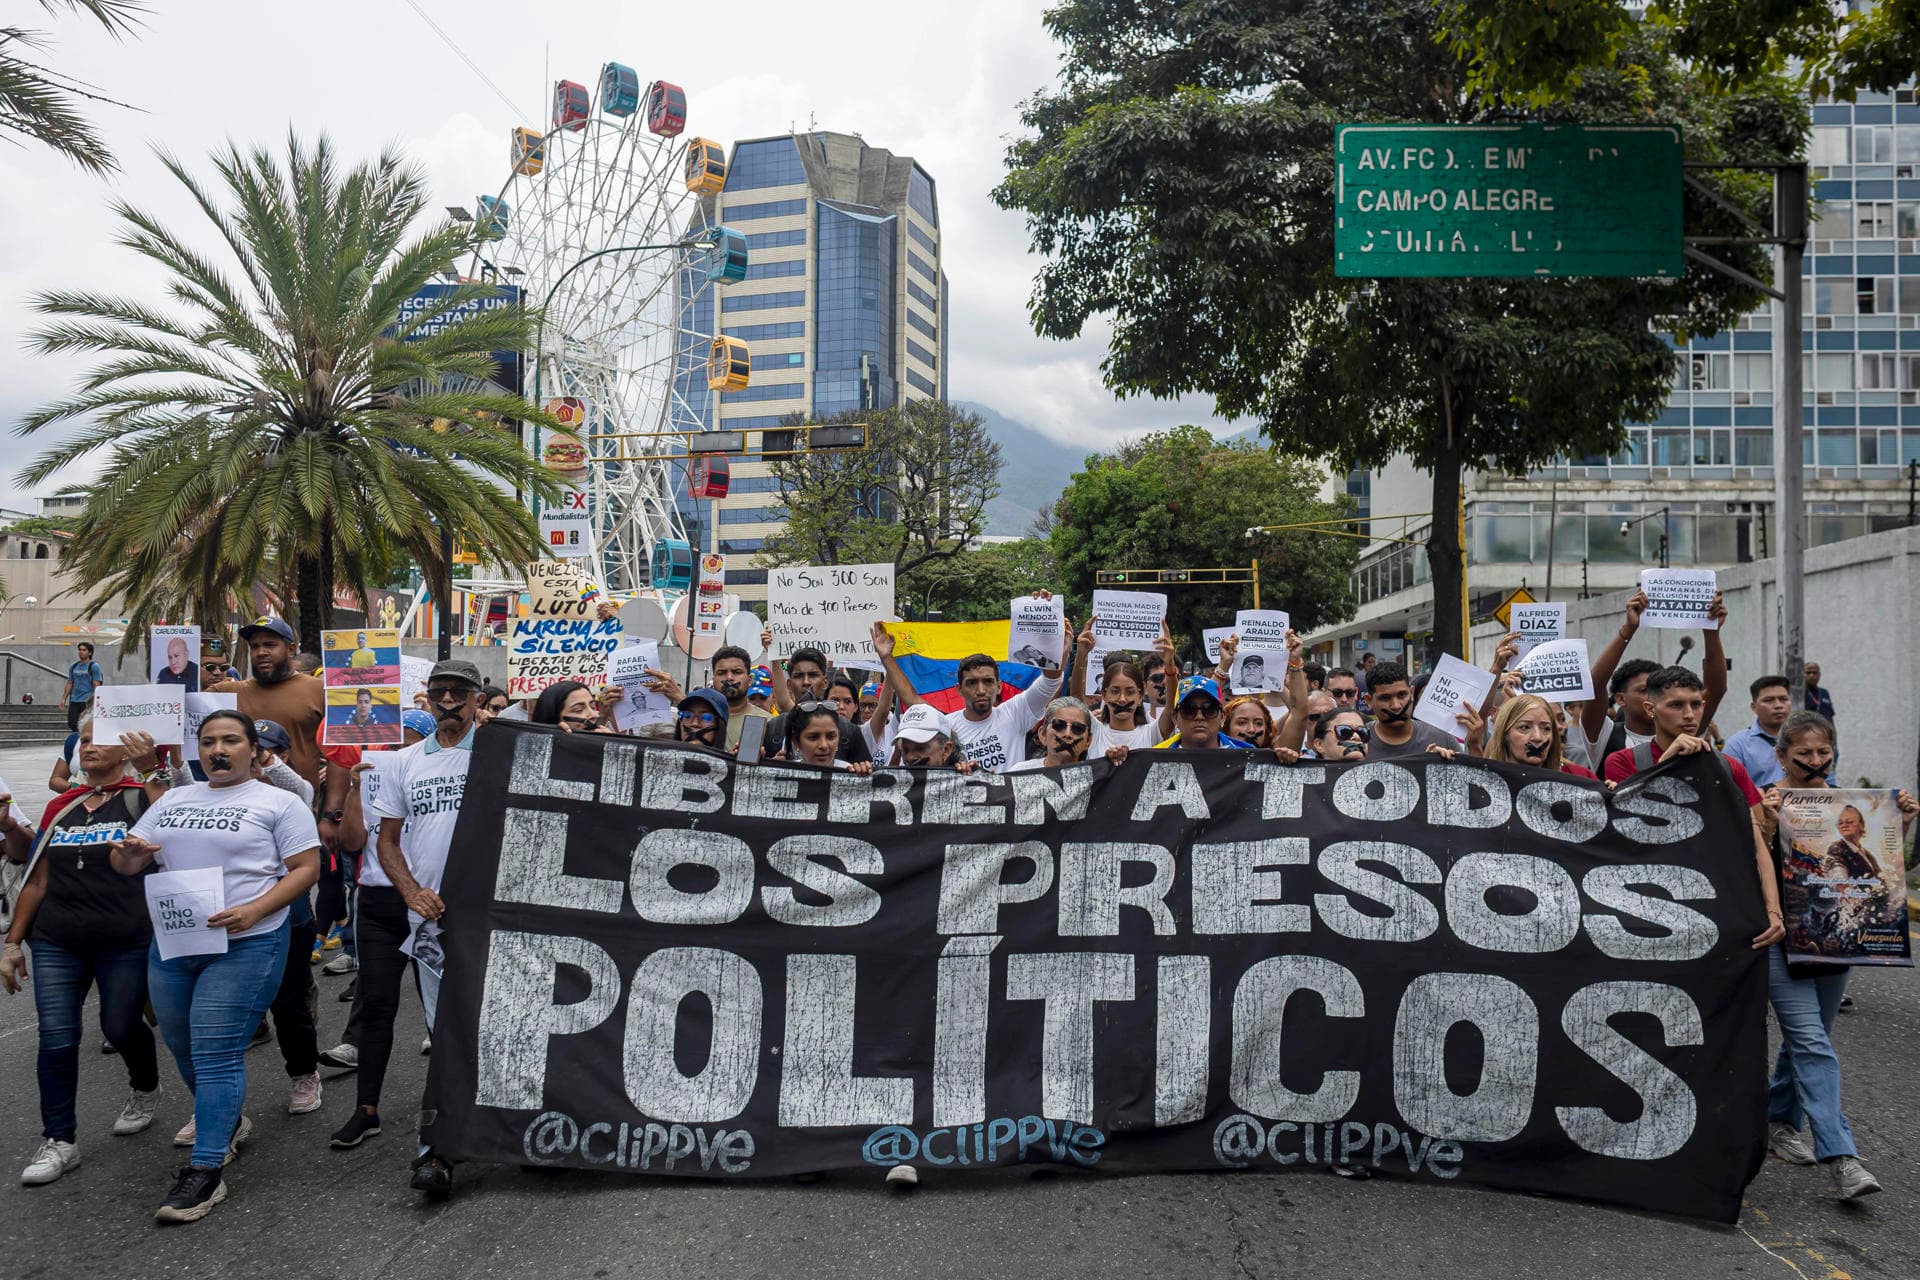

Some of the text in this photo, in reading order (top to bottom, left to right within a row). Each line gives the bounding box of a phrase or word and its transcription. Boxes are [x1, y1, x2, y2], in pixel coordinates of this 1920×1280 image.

[1358, 148, 1396, 170] AV.
[484, 298, 508, 310] UN
[542, 513, 589, 521] Mundialistas
[830, 569, 857, 587] 300
[553, 590, 573, 598] DE
[533, 598, 588, 616] LUTO
[700, 602, 721, 613] ESP
[818, 600, 838, 615] 700
[1097, 601, 1161, 611] NINGUNA MADRE
[1096, 620, 1159, 631] BAJO CUSTODIA
[1241, 620, 1285, 628] REINALDO
[1520, 617, 1557, 630] DÍAZ
[1095, 629, 1160, 640] DEL ESTADO
[1245, 628, 1281, 636] ARAUJO
[513, 637, 619, 654] SILENCIO
[835, 639, 857, 655] PARA
[508, 655, 574, 666] LIBERTAD
[617, 655, 648, 666] RAFAEL
[518, 664, 605, 677] TODOS LOS
[1439, 676, 1452, 687] NI
[1523, 676, 1581, 691] CÁRCEL
[1435, 685, 1459, 700] UNO
[967, 743, 1002, 760] PRESOS
[411, 776, 446, 790] LIBEREN
[508, 731, 1705, 845] LIBEREN A TODOS
[411, 788, 432, 802] LOS
[1782, 791, 1834, 807] Carmen
[50, 828, 126, 844] CUENTA
[494, 807, 1720, 962] LOS PRESOS
[159, 899, 174, 910] NI
[161, 908, 193, 921] UNO
[164, 918, 196, 931] MÁS
[1857, 930, 1904, 944] Venezuela
[475, 929, 1705, 1160] POLÍTICOS
